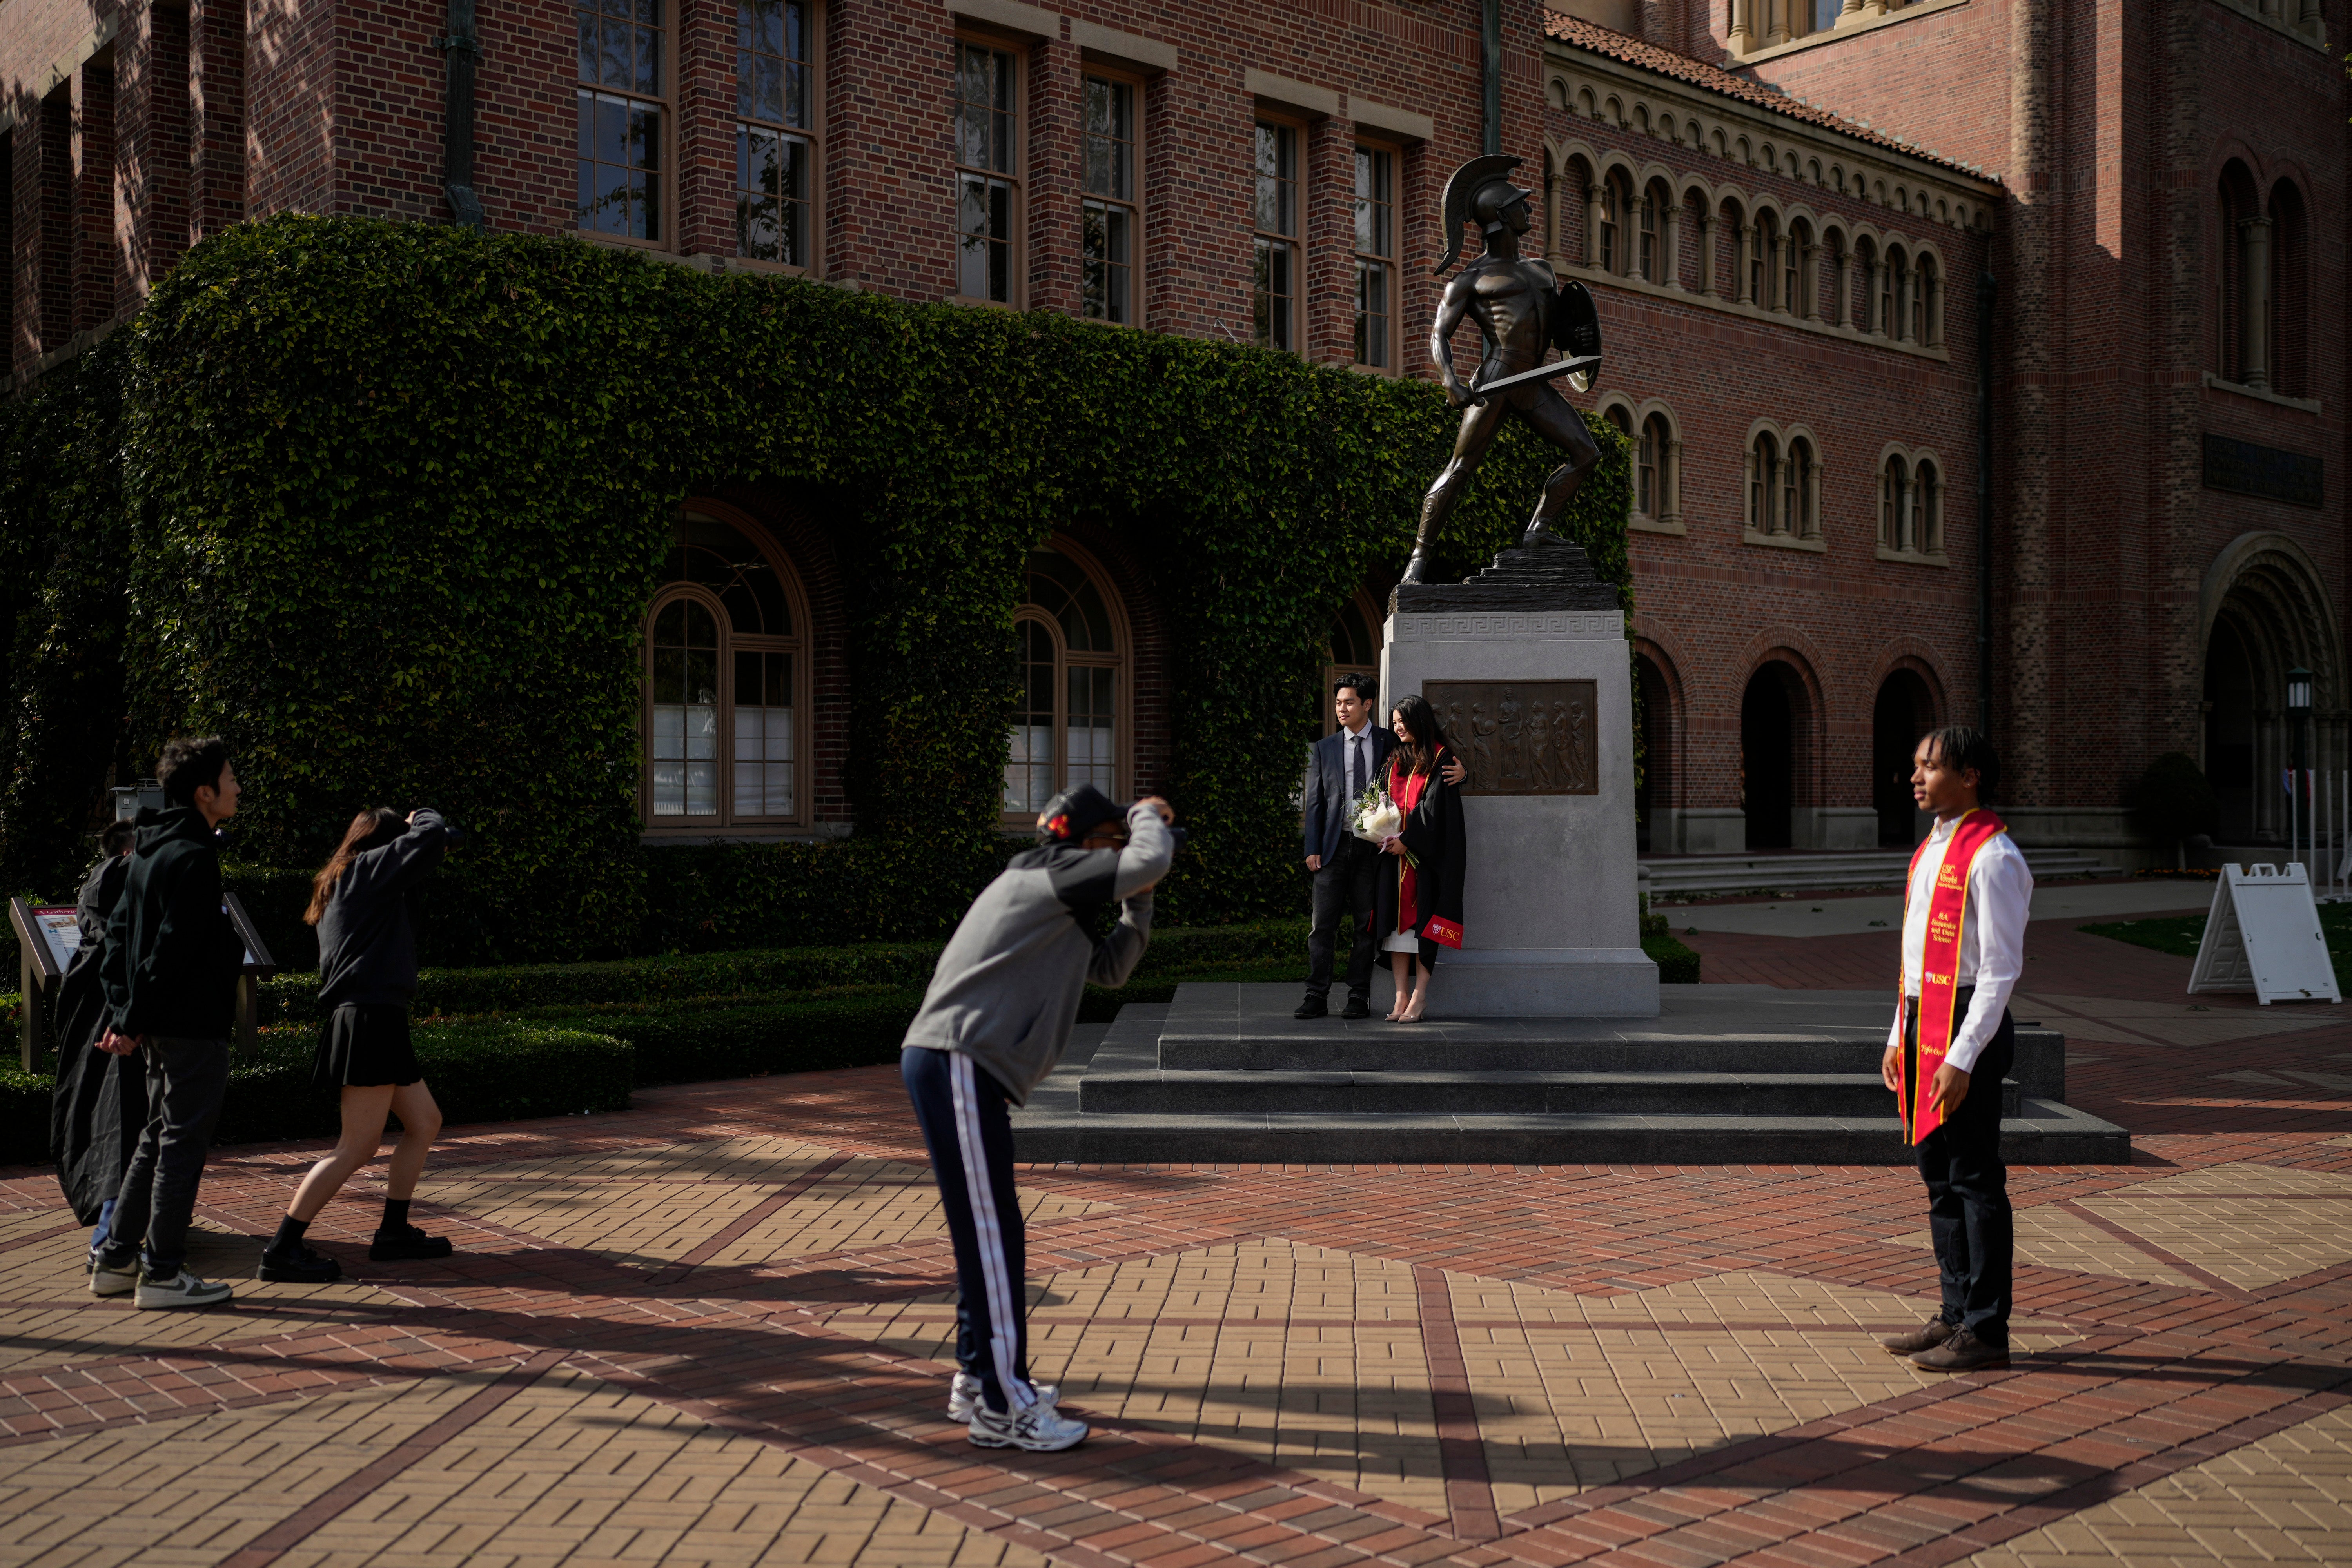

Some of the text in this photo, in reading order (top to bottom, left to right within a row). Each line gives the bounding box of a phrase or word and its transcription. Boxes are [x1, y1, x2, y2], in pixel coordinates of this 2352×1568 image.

[1942, 864, 1955, 875] USC
[1940, 873, 1958, 885] Viterbi
[1441, 927, 1460, 941] USC
[1933, 934, 1951, 944] Science
[1932, 973, 1951, 986] USC
